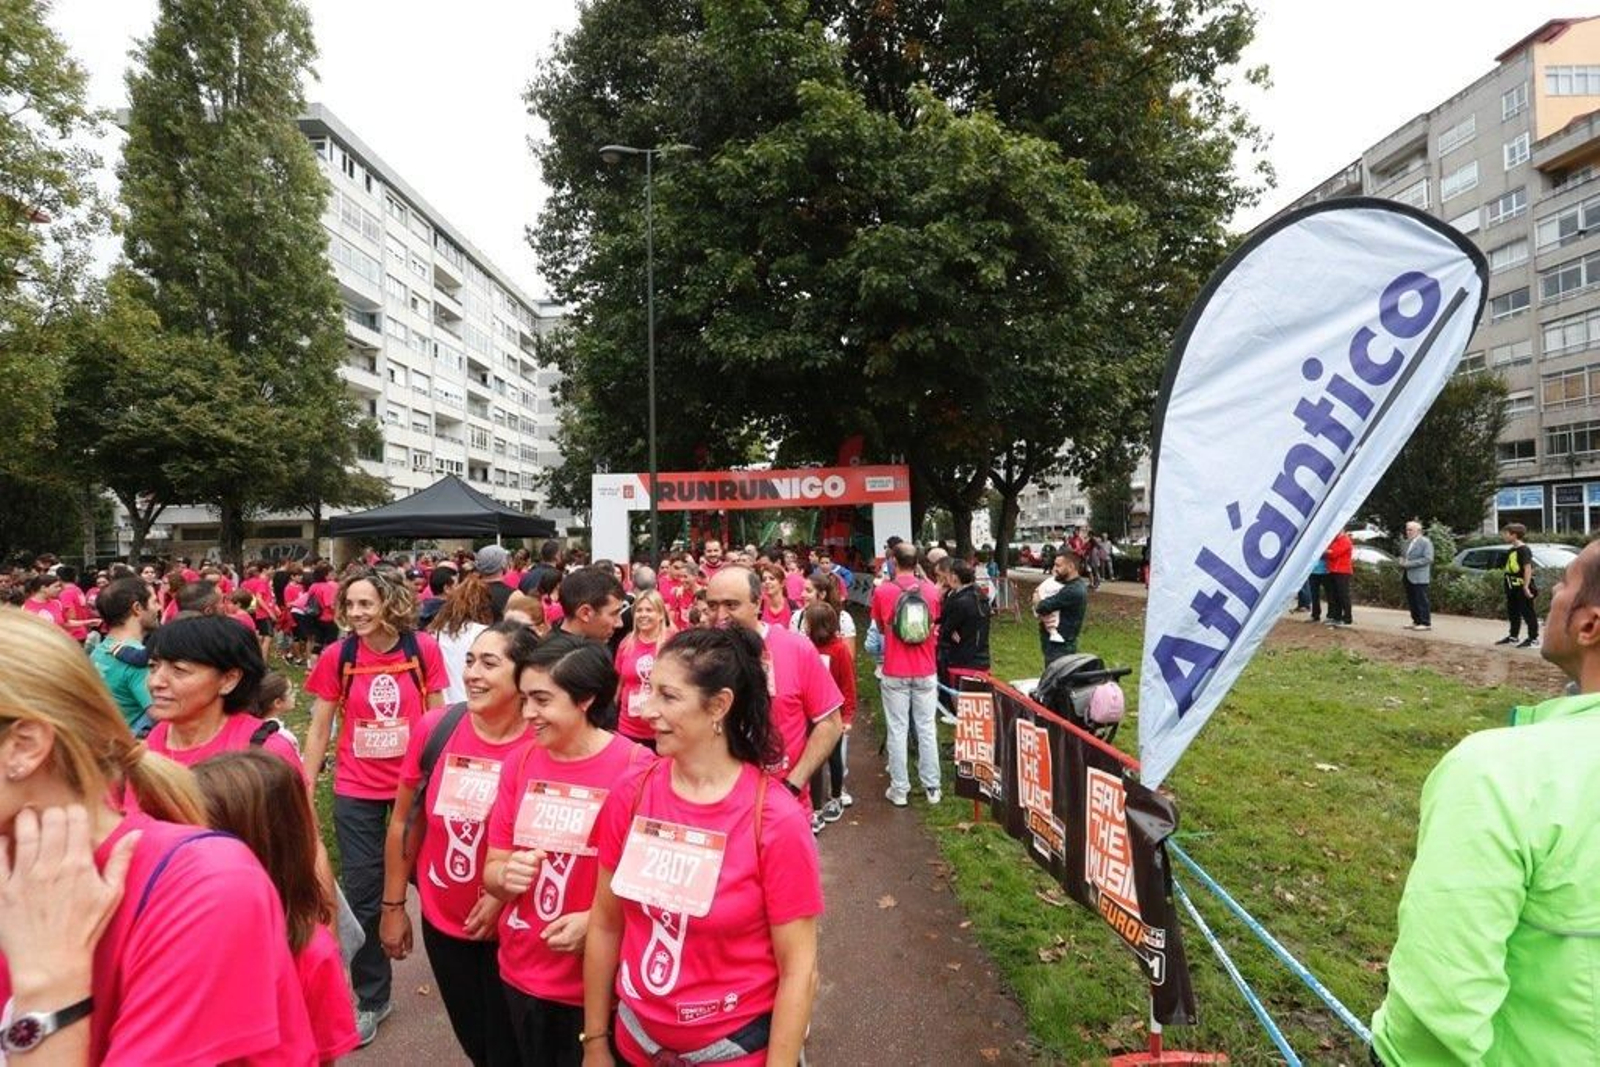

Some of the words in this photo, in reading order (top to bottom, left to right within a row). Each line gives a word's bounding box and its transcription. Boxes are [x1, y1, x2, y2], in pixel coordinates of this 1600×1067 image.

[1152, 270, 1441, 720] Atlántico
[956, 719, 985, 740] THE
[532, 803, 586, 834] 2998
[1091, 779, 1127, 820] SAV
[1091, 811, 1126, 859] THE
[641, 846, 701, 887] 2807
